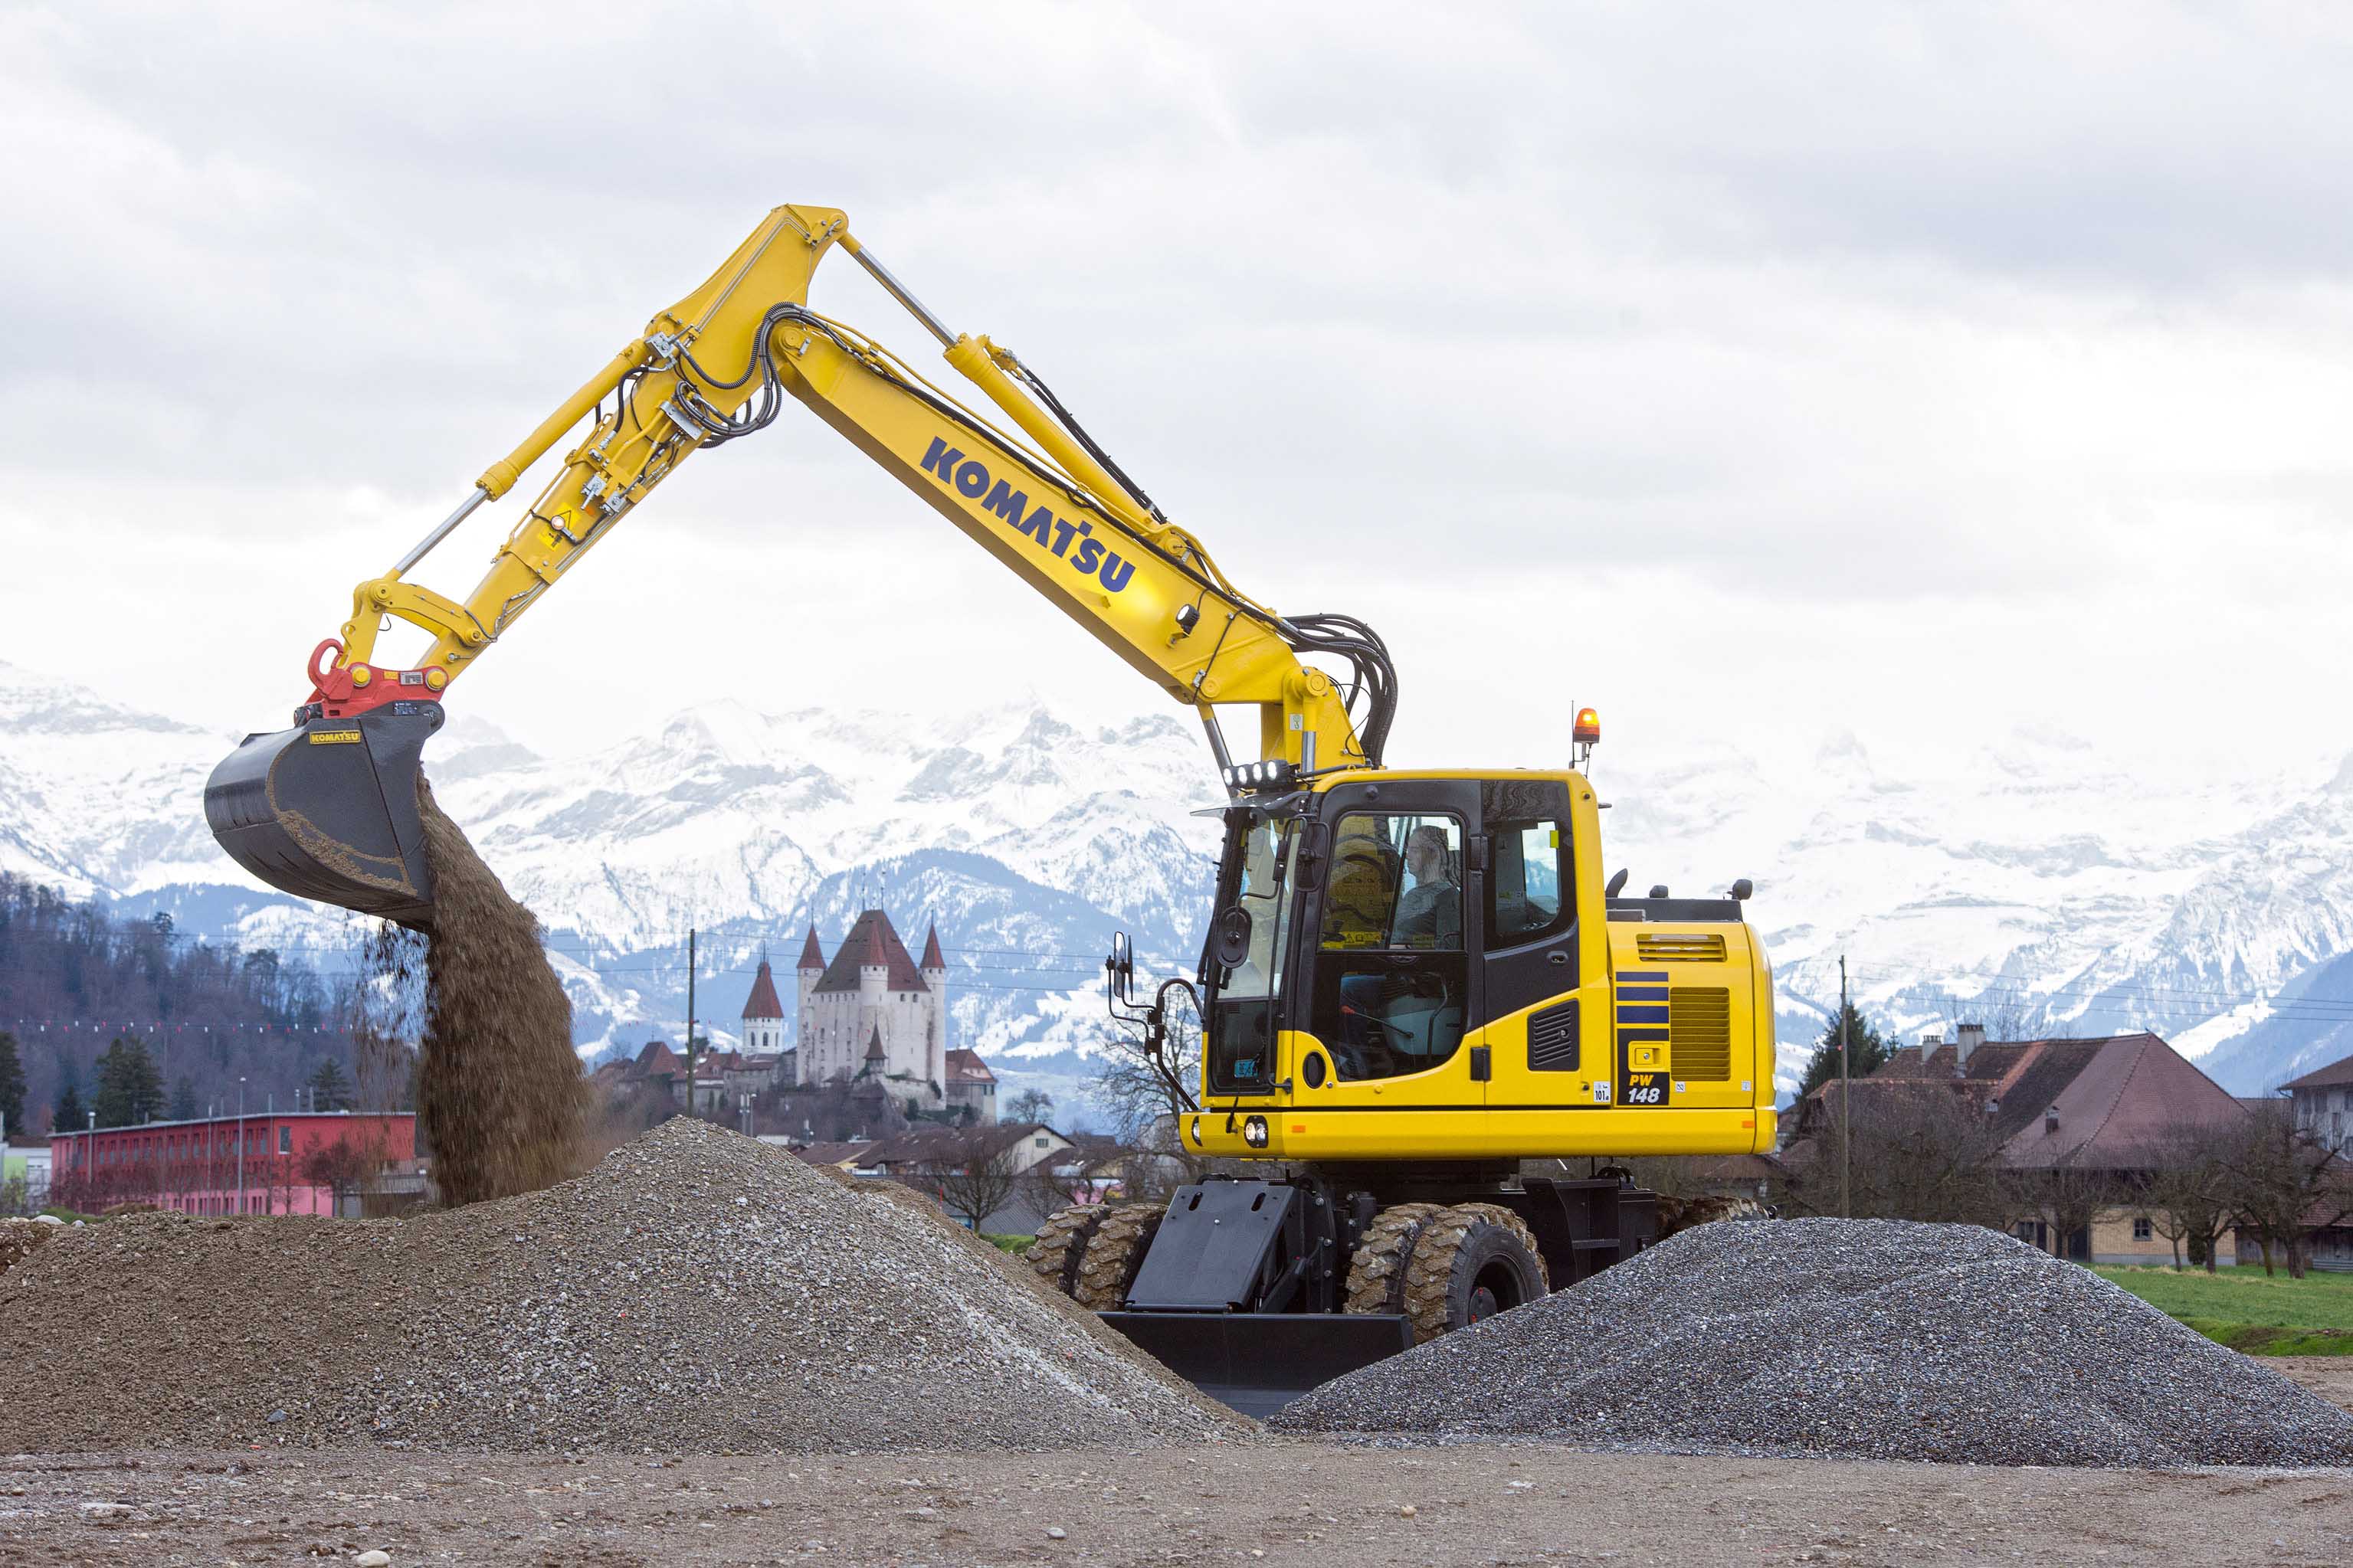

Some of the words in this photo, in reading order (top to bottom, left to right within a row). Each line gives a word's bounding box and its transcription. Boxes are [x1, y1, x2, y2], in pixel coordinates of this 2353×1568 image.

[919, 436, 1136, 592] KOMATSU
[311, 732, 359, 742] KOMATSU
[1629, 1075, 1653, 1086] PW
[1595, 1090, 1605, 1101] 101
[1628, 1088, 1660, 1103] 148
